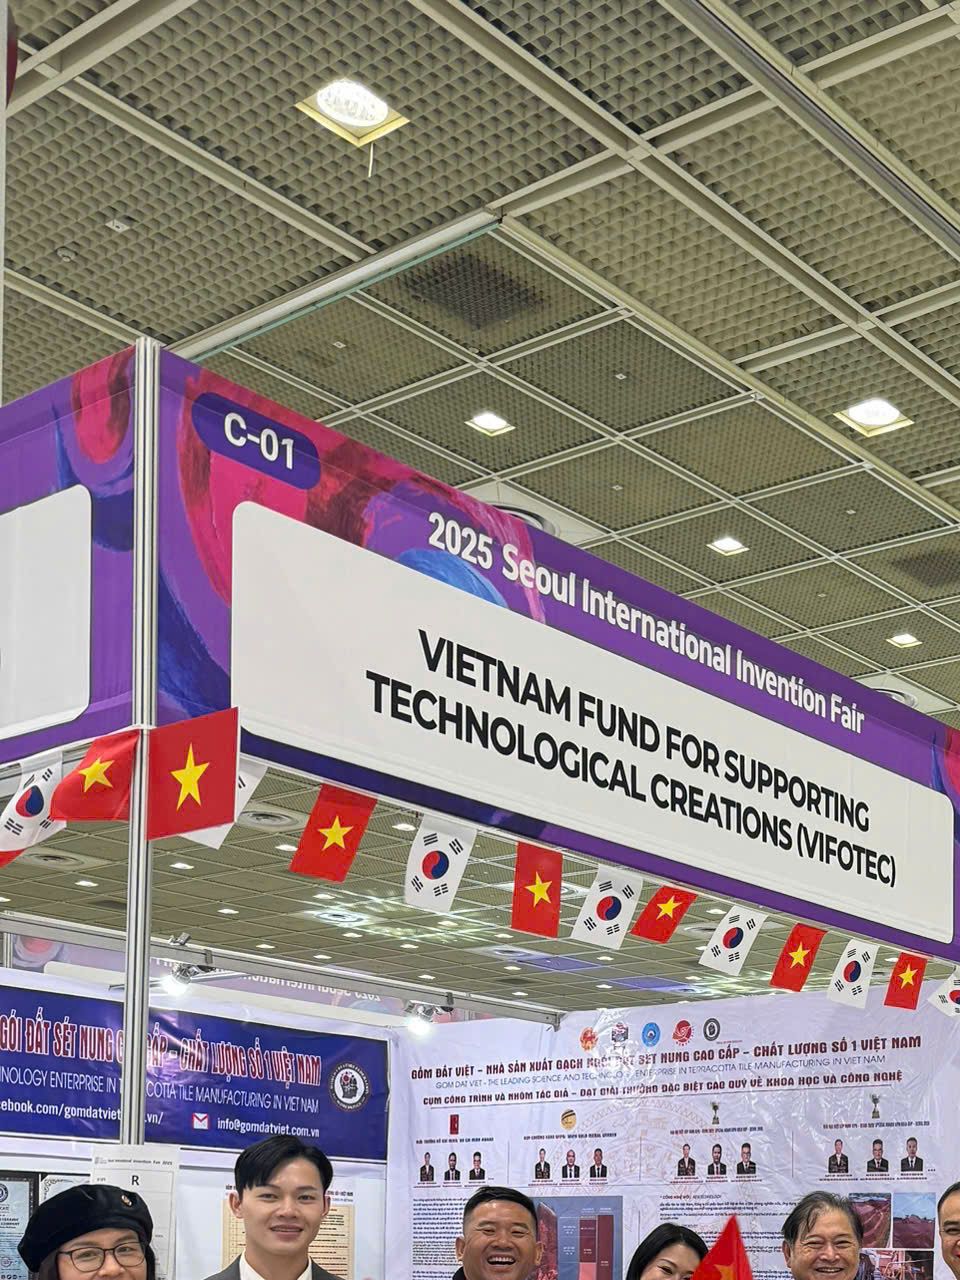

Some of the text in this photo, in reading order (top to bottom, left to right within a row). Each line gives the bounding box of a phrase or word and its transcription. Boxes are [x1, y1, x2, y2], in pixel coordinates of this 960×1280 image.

[224, 411, 296, 470] C-01
[428, 512, 865, 734] 2025 Seoul International Invention Fair
[418, 628, 870, 833] VIETNAM FUND FOR SUPPORTING
[365, 670, 896, 887] TECHNOLOGICAL CREATIONS (VIFOTEC)
[0, 1009, 22, 1052] GÓI
[25, 1006, 51, 1056] ĐẤT
[53, 1016, 77, 1058] SÉT
[79, 1025, 114, 1062] NUNG
[146, 1022, 168, 1068] ẤP
[179, 1029, 209, 1072] CHẤT
[211, 1040, 247, 1082] LƯỢNG
[248, 1037, 264, 1079] SỐ
[264, 1050, 272, 1080] 1
[271, 1045, 296, 1089] VIỆT
[296, 1054, 322, 1087] NAM
[556, 1059, 583, 1073] GẠCH
[661, 1051, 689, 1064] NUNG
[693, 1048, 714, 1061] CAO
[718, 1044, 740, 1060] CẤP
[754, 1041, 784, 1057] CHẤT
[788, 1040, 827, 1057] LƯỢNG
[831, 1036, 848, 1053] SỐ
[851, 1040, 857, 1051] 1
[861, 1036, 887, 1053] VIỆT
[891, 1035, 921, 1049] NAM
[563, 1073, 580, 1081] AND
[679, 1066, 687, 1074] IN
[740, 1062, 752, 1071] TILE
[754, 1058, 830, 1070] MANUFACTURING
[832, 1057, 842, 1065] IN
[844, 1056, 861, 1065] VIET
[863, 1055, 886, 1064] NAM
[50, 1071, 104, 1093] ENTERPRISE
[106, 1077, 116, 1094] IN
[178, 1084, 194, 1101] TILE
[196, 1086, 271, 1108] MANUFACTURING
[273, 1096, 283, 1110] IN
[283, 1096, 300, 1111] VIET
[300, 1099, 319, 1113] NAM
[707, 1080, 725, 1090] CAO
[766, 1076, 795, 1087] KHOA
[798, 1076, 820, 1087] HỌC
[823, 1073, 837, 1084] VÀ
[840, 1072, 870, 1084] CÔNG
[873, 1069, 903, 1083] NGHỆ
[217, 1117, 320, 1138] info@gomdatviet.com.vn
[131, 1175, 140, 1186] R
